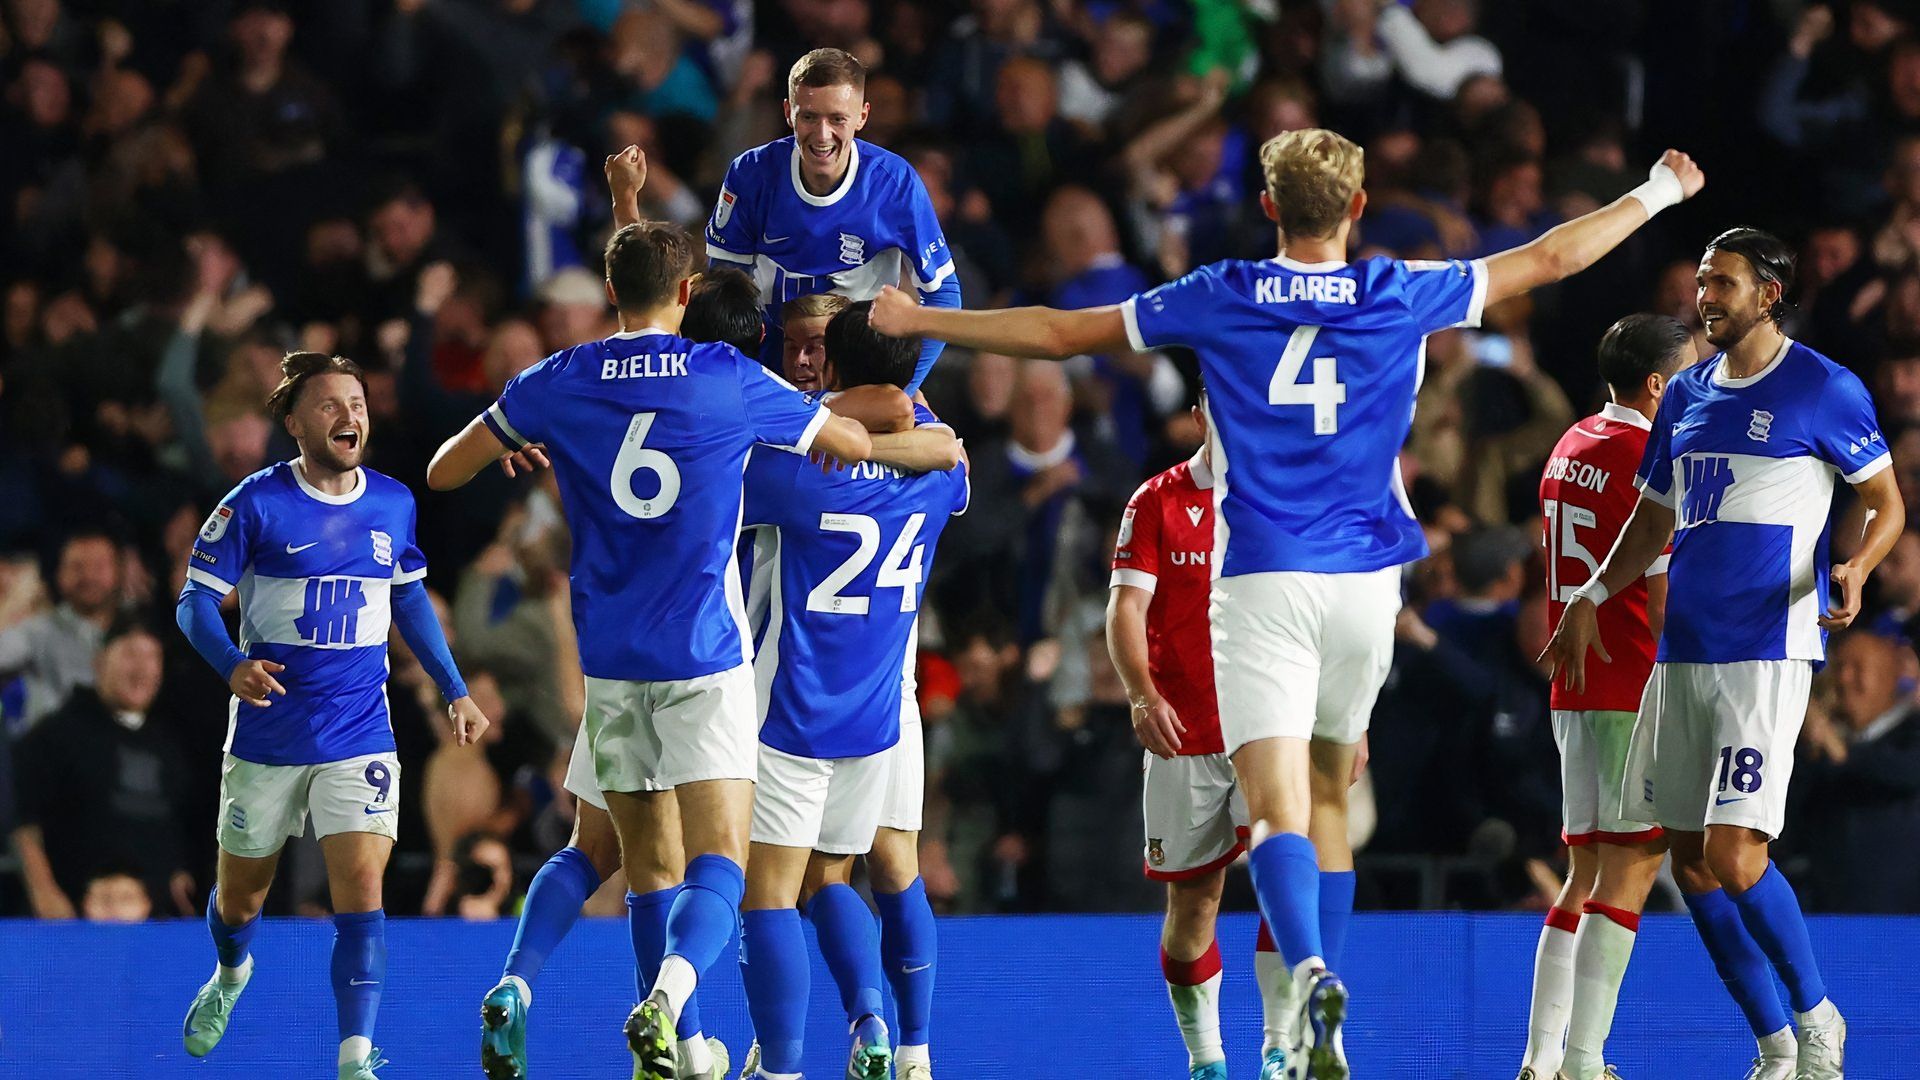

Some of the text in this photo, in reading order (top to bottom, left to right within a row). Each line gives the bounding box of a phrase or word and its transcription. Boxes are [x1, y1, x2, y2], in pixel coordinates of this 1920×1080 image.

[1255, 275, 1358, 305] KLARER
[601, 353, 688, 380] BIELIK
[1269, 325, 1346, 435] 4
[610, 412, 681, 519] 6
[1545, 456, 1610, 494] DOBSON
[806, 512, 927, 615] 24
[1544, 499, 1599, 603] 15
[364, 760, 392, 802] 9
[1718, 746, 1763, 793] 18
